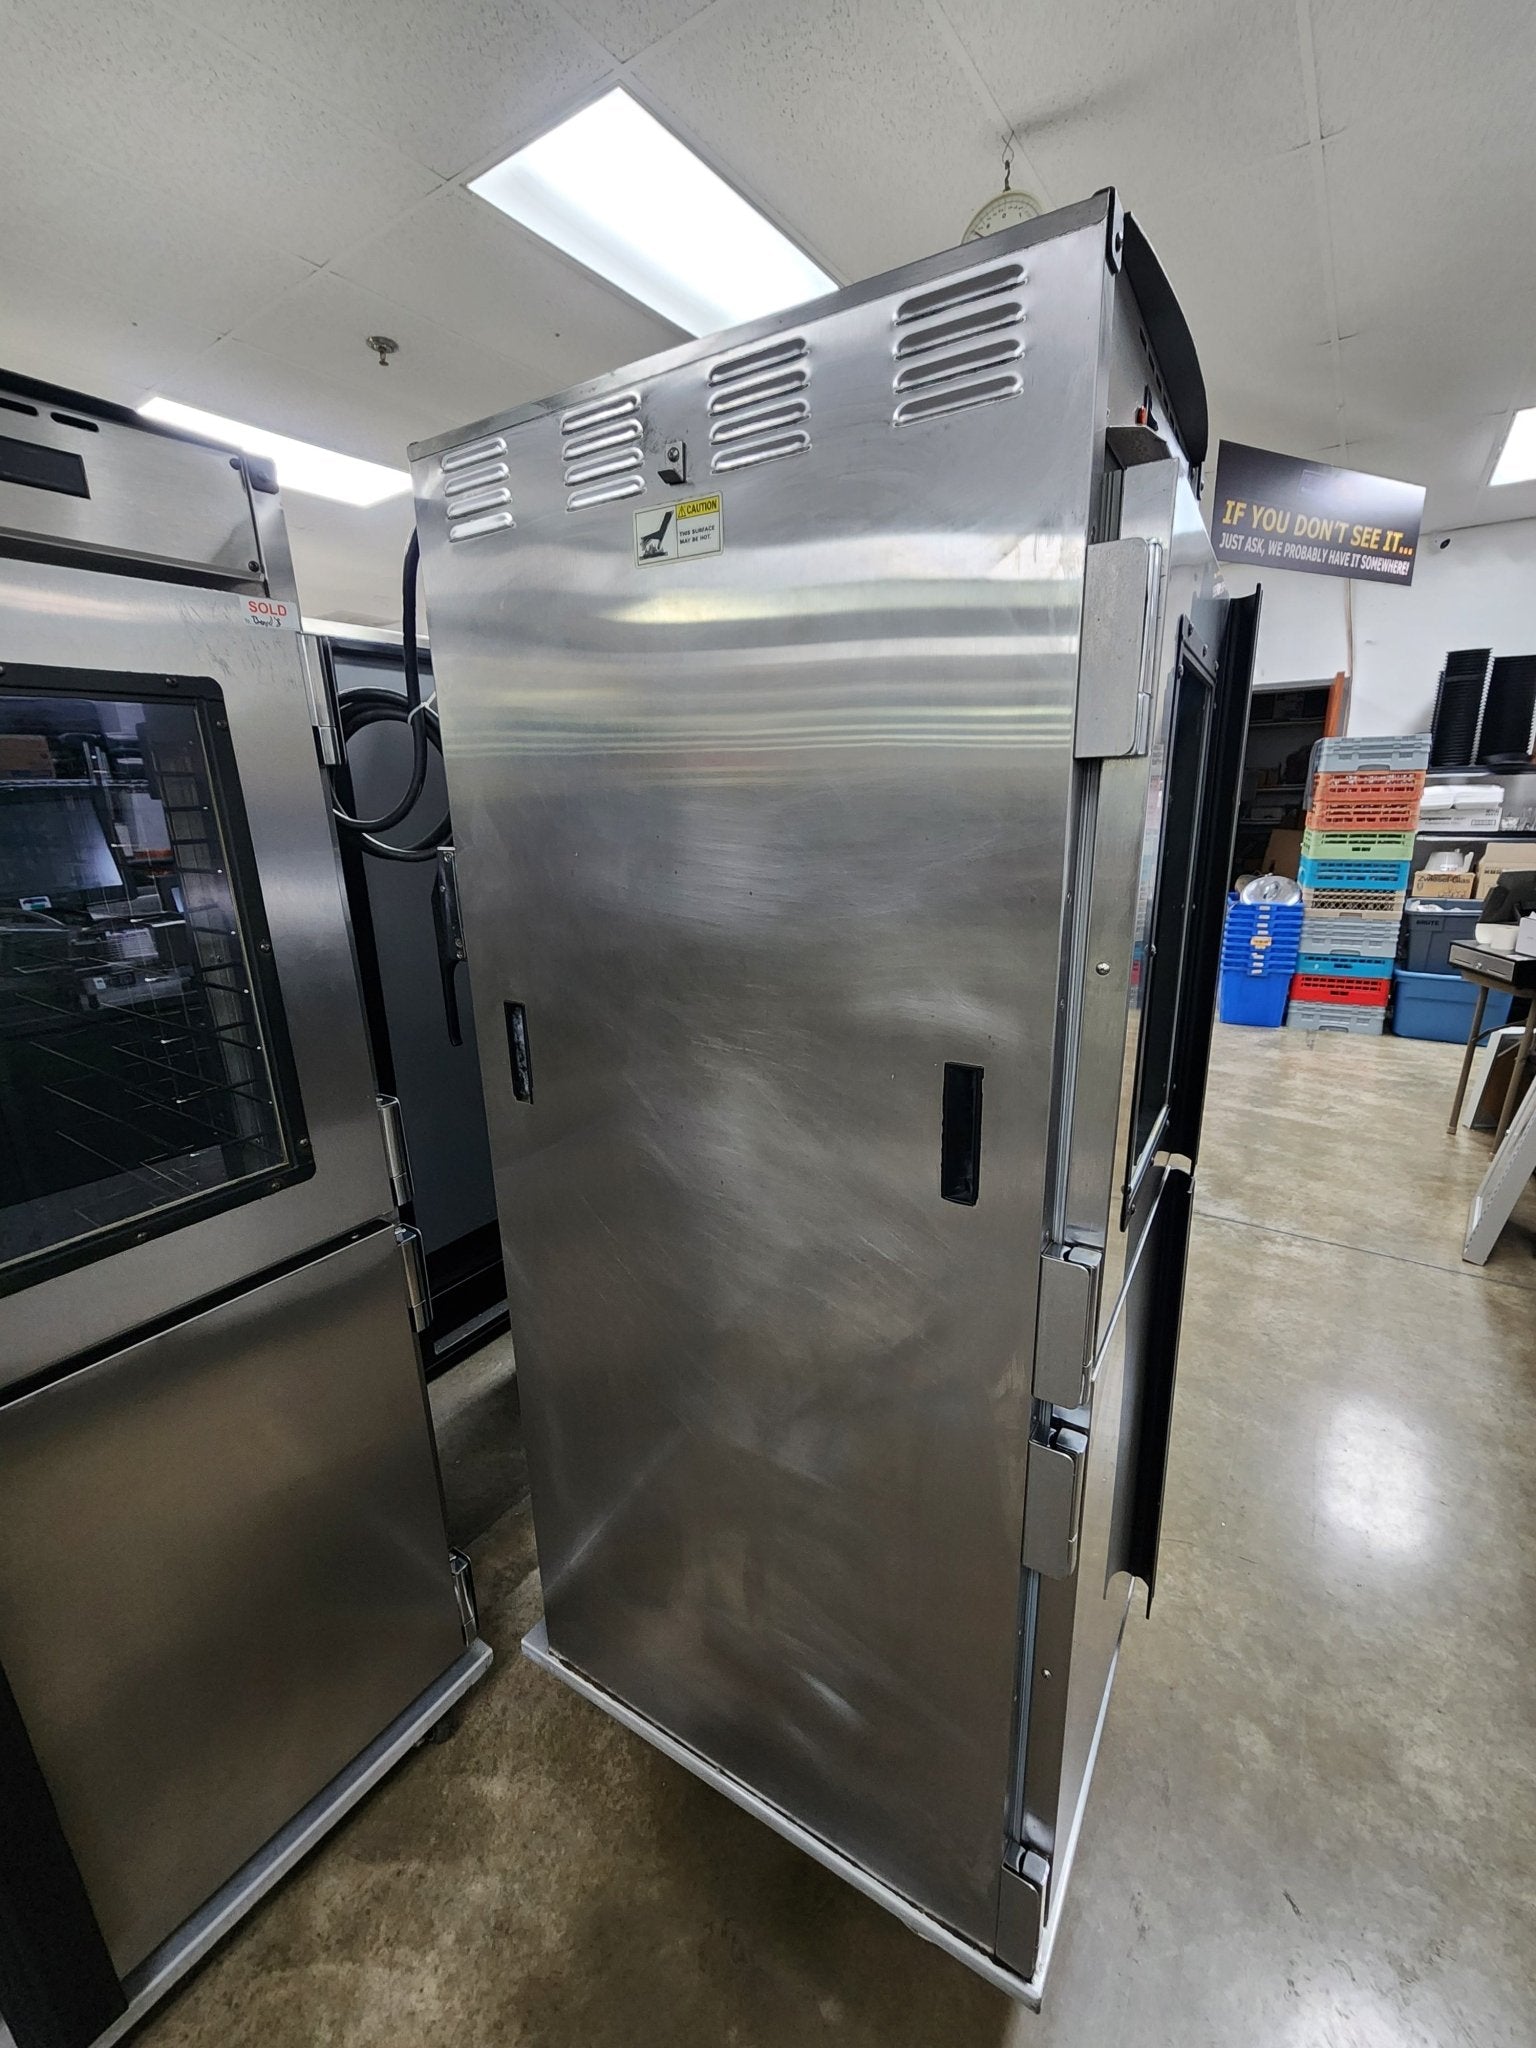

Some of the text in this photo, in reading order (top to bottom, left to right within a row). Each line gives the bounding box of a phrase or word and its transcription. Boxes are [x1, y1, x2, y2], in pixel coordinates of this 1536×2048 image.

[686, 499, 717, 515] CAUTION
[692, 525, 714, 534] SURFACE
[1223, 500, 1414, 556] IF YOU DON'T SEE IT...
[1219, 532, 1409, 576] JUST ASK, WE PROBABLY HAVE IT SOMEWHERE!
[248, 600, 287, 616] SOLD
